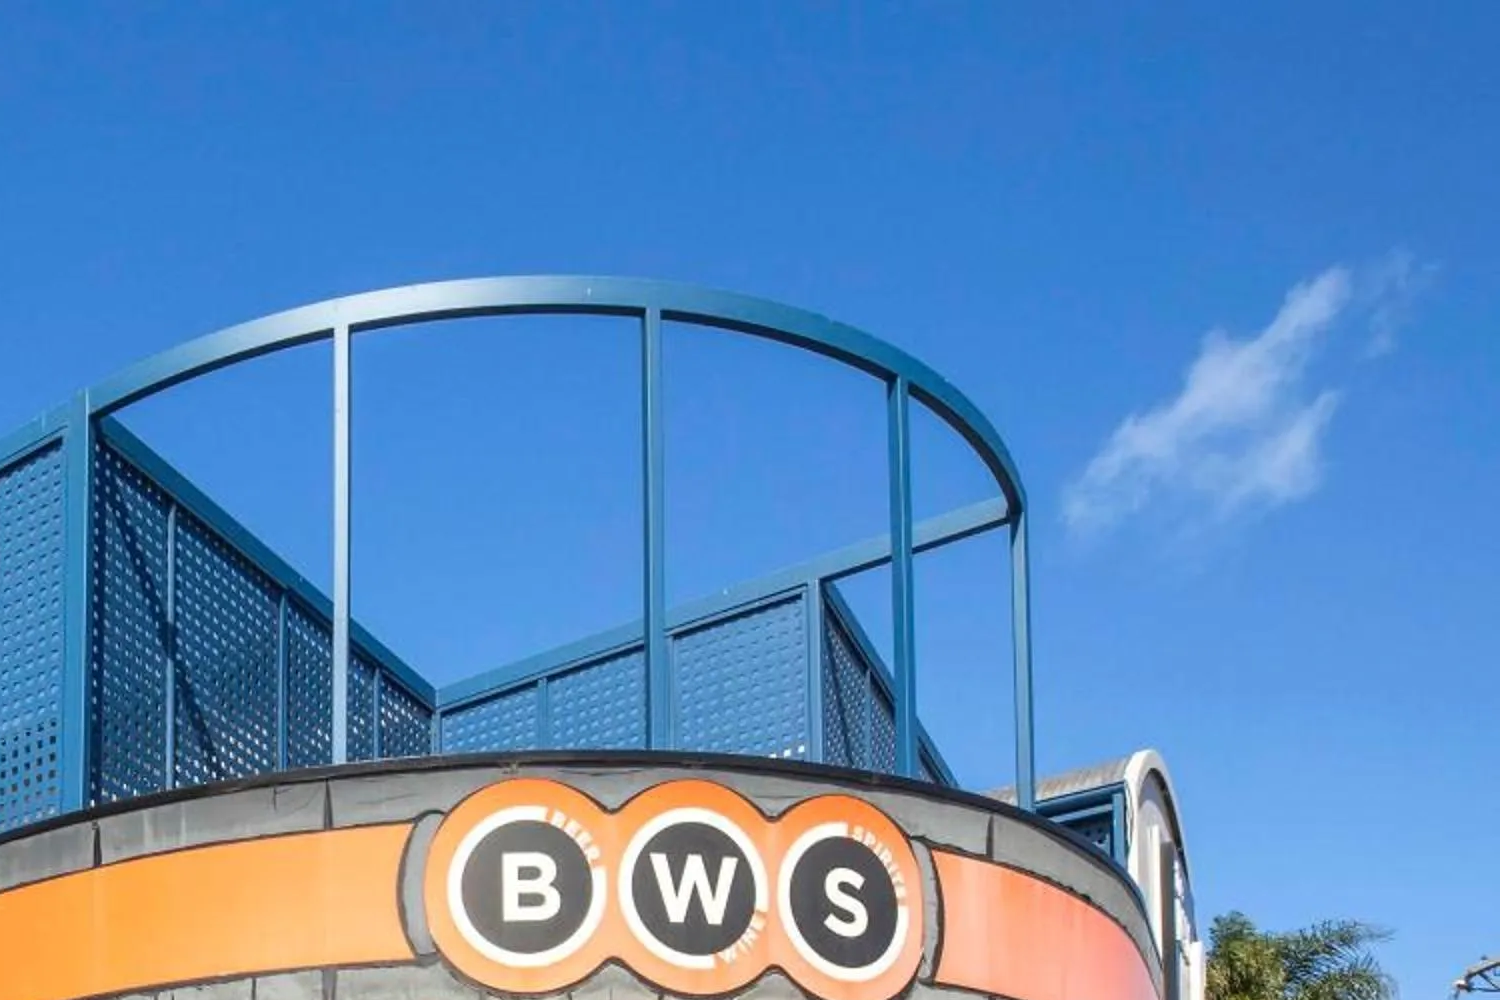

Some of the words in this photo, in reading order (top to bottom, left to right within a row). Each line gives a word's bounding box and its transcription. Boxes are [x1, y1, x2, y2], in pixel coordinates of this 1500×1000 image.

[551, 808, 601, 866] BEER
[851, 825, 907, 899] SPIRITS
[714, 912, 767, 965] WINE
